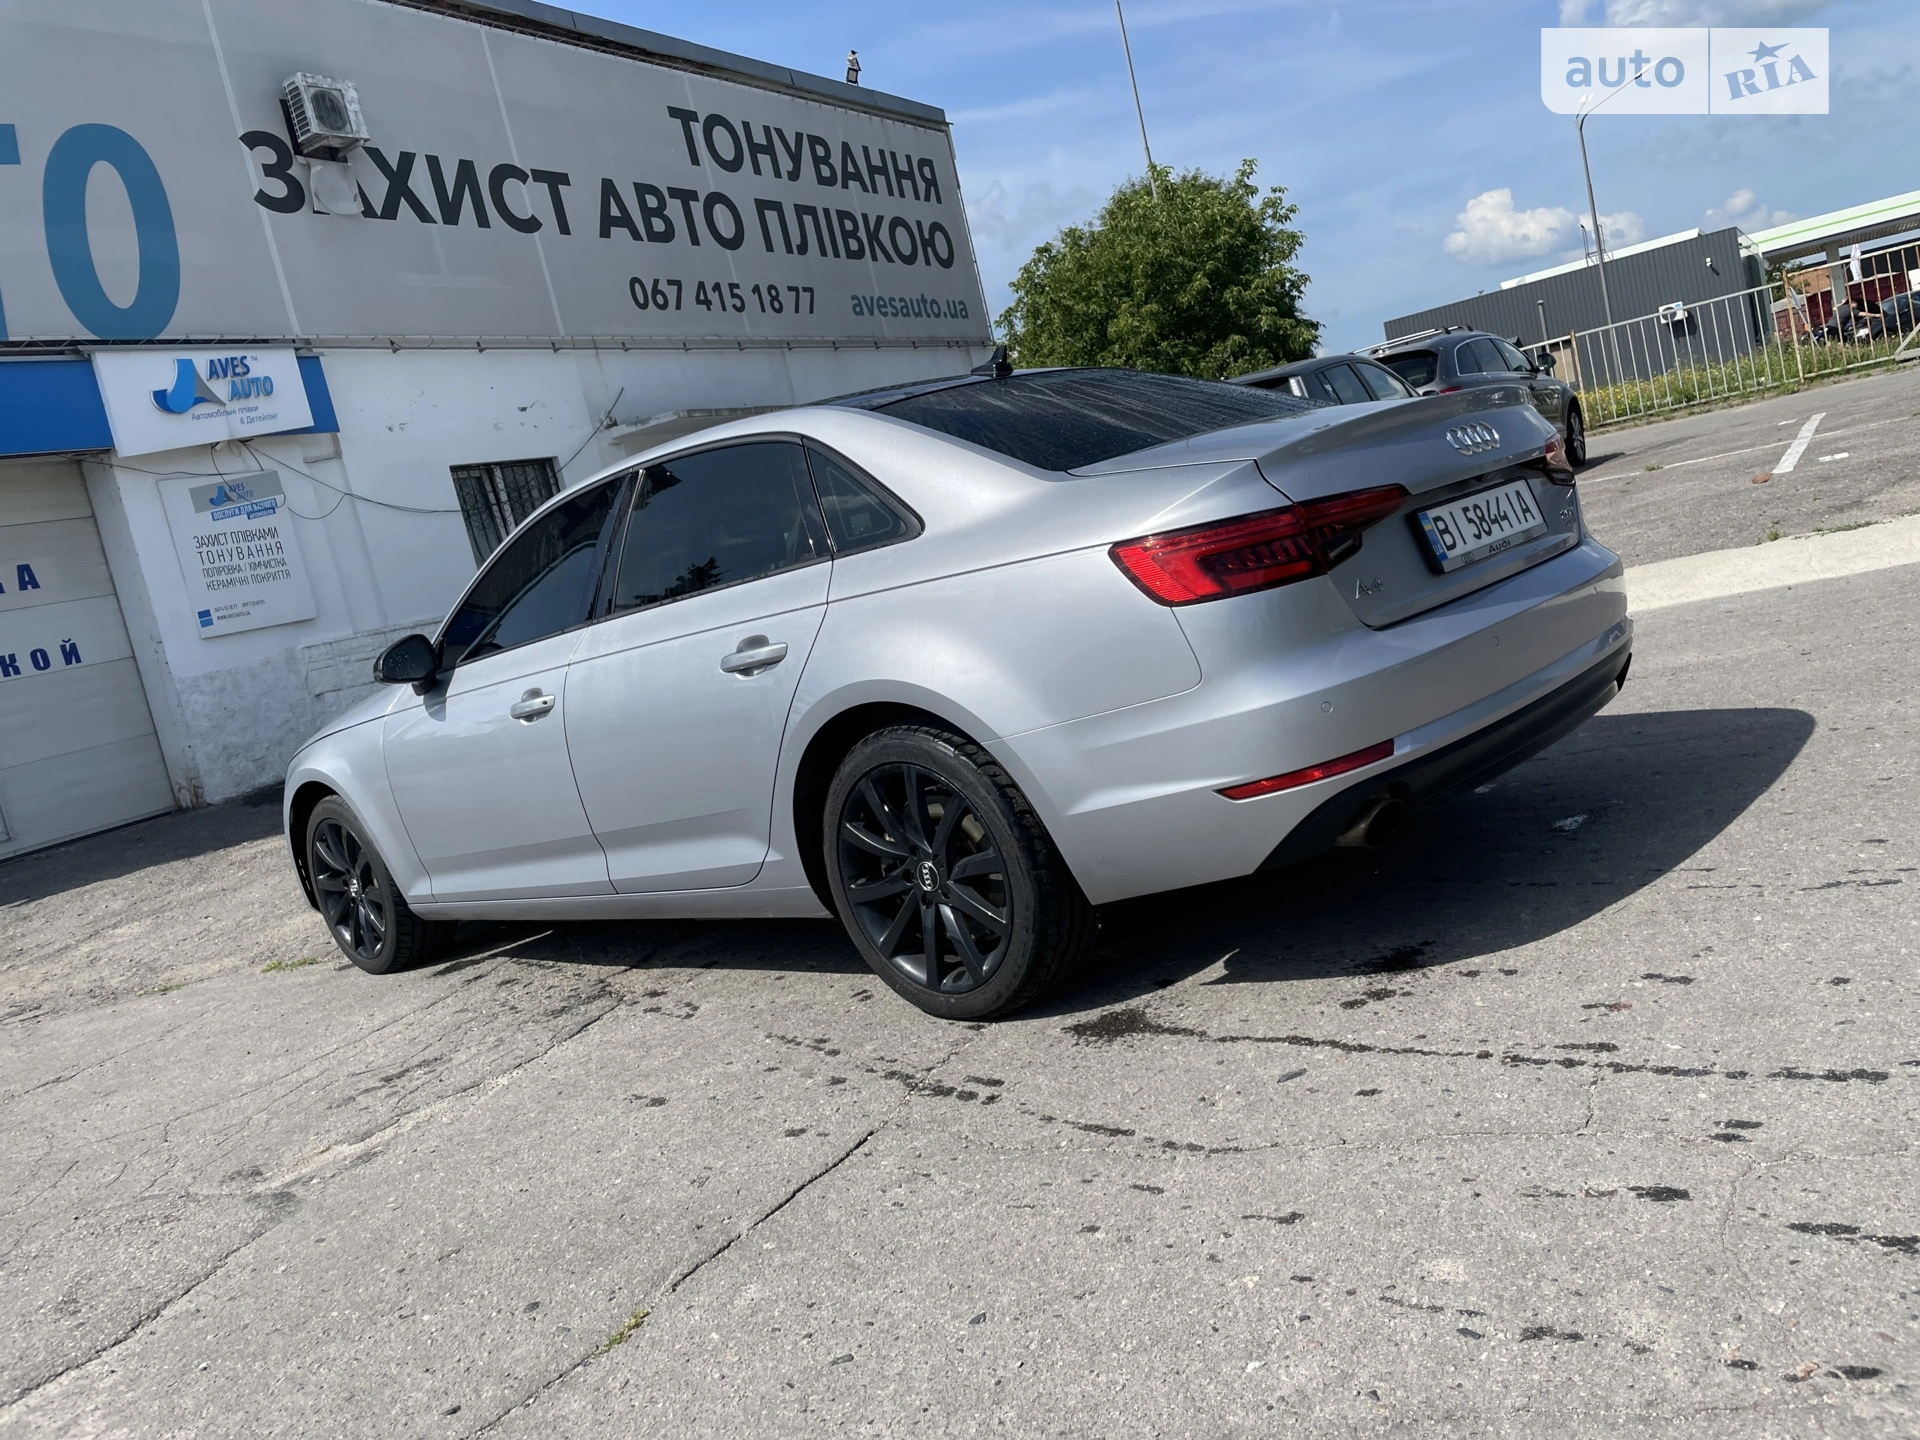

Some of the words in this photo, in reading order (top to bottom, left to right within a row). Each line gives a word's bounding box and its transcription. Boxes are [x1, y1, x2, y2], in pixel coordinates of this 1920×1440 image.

[667, 105, 943, 204] ТОНУВАННЯ
[599, 177, 745, 250] АВТО
[754, 197, 955, 270] ПЛІВКОЮ
[629, 277, 682, 310] 067
[695, 281, 746, 313] 415
[751, 283, 784, 314] 18
[787, 286, 814, 315] 77
[851, 292, 969, 320] avesauto.ua
[207, 355, 251, 381] AVES
[228, 375, 274, 401] AUTO
[192, 408, 236, 421] Автомобільні
[238, 405, 259, 415] плівки
[240, 416, 245, 425] &
[246, 413, 278, 425] Детейлінг
[229, 483, 245, 493] AVES
[237, 490, 254, 500] AUTO
[213, 507, 240, 520] ПОСЛУГИ
[240, 504, 253, 515] ДЛЯ
[1432, 511, 1467, 551] BI
[1461, 496, 1514, 540] 5844
[1505, 490, 1536, 525] IA
[193, 532, 229, 549] ЗАХИСТ
[230, 526, 279, 544] ПЛІВКАМИ
[1488, 539, 1511, 555] Audi
[197, 541, 284, 566] ТОНУВАННЯ
[1434, 543, 1445, 556] UA
[202, 563, 243, 578] ПОЛІРОВКА
[248, 557, 287, 572] ХІМЧИСТКА
[206, 576, 250, 591] КЕРАМІЧНІ
[250, 569, 291, 585] ПОКРИТТЯ
[1355, 577, 1384, 600] A4
